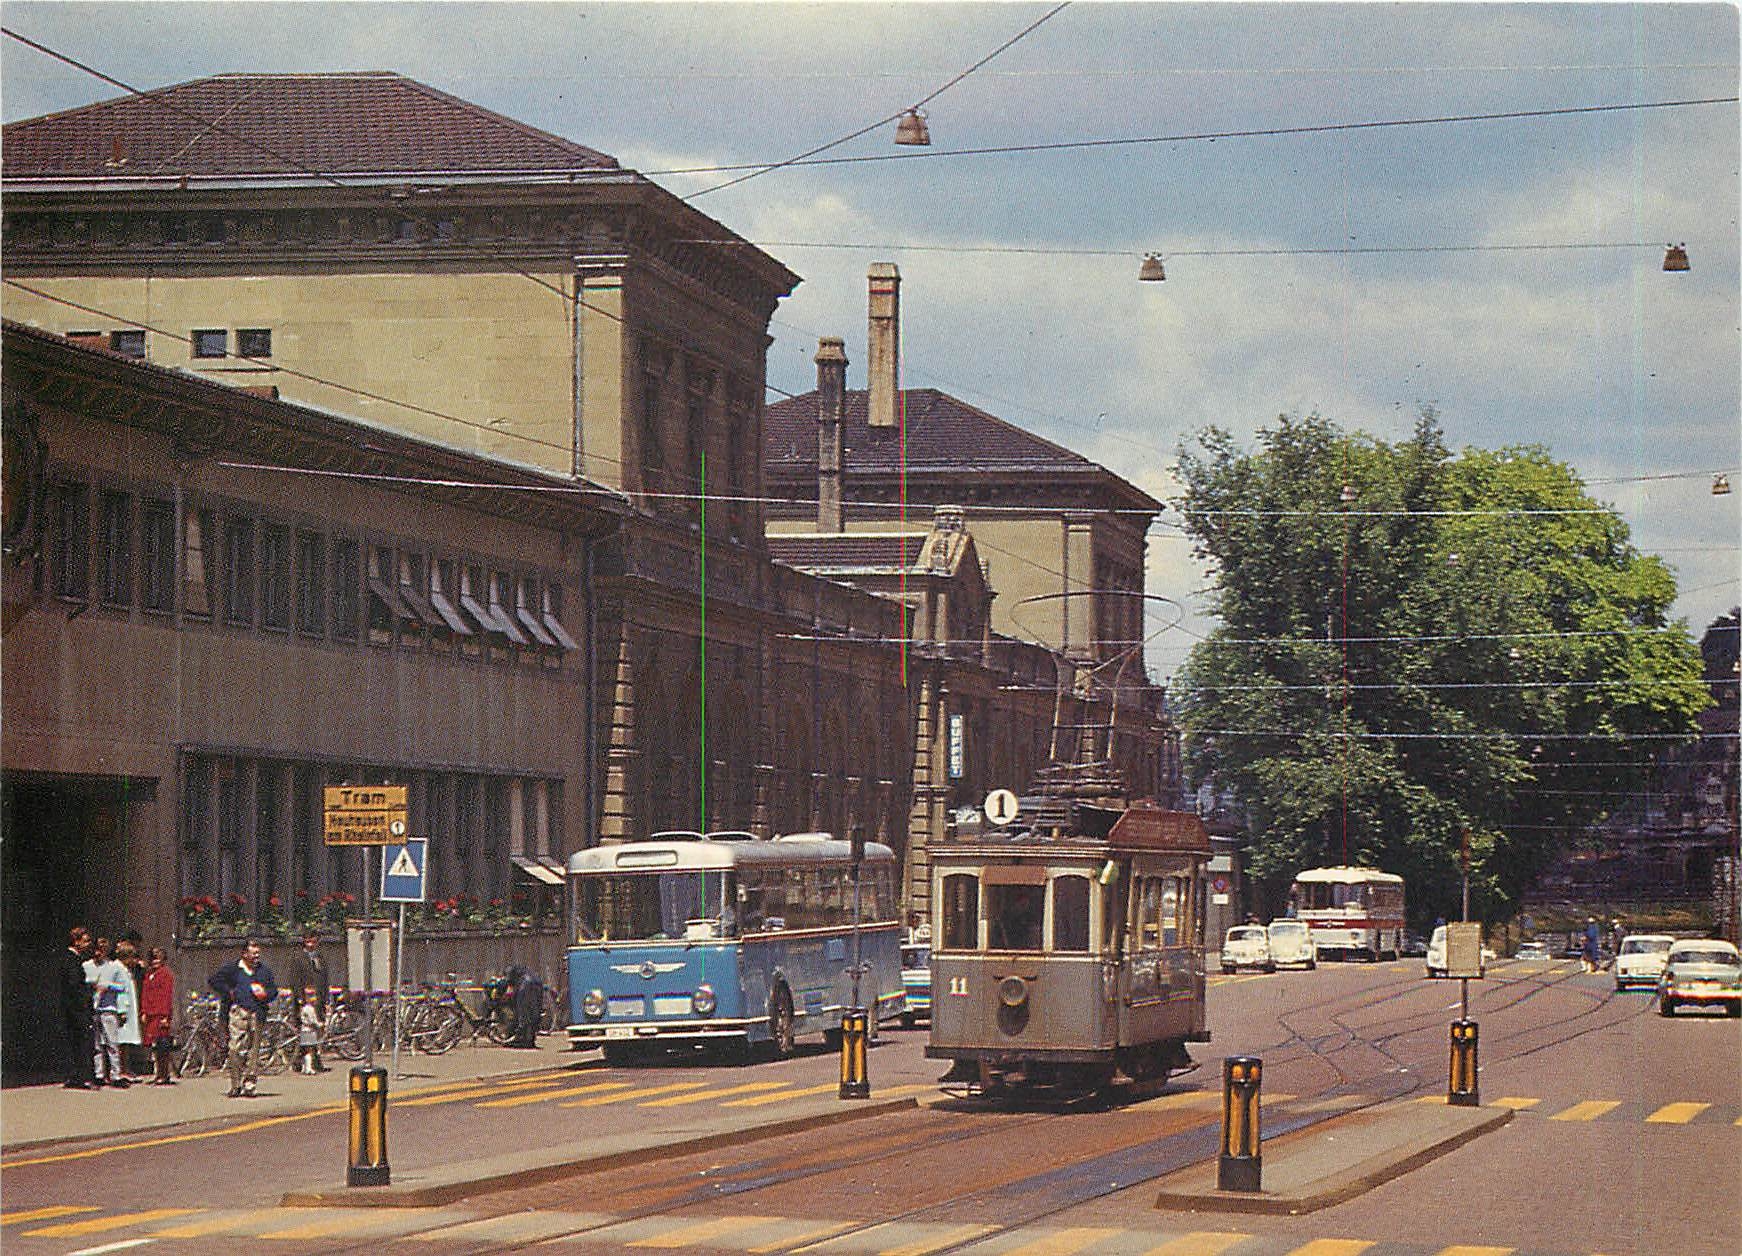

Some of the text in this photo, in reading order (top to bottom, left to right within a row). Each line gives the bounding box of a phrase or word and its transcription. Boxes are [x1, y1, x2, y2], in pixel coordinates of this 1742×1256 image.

[340, 789, 386, 805] Tram
[994, 793, 1008, 819] 1
[950, 976, 969, 995] 11
